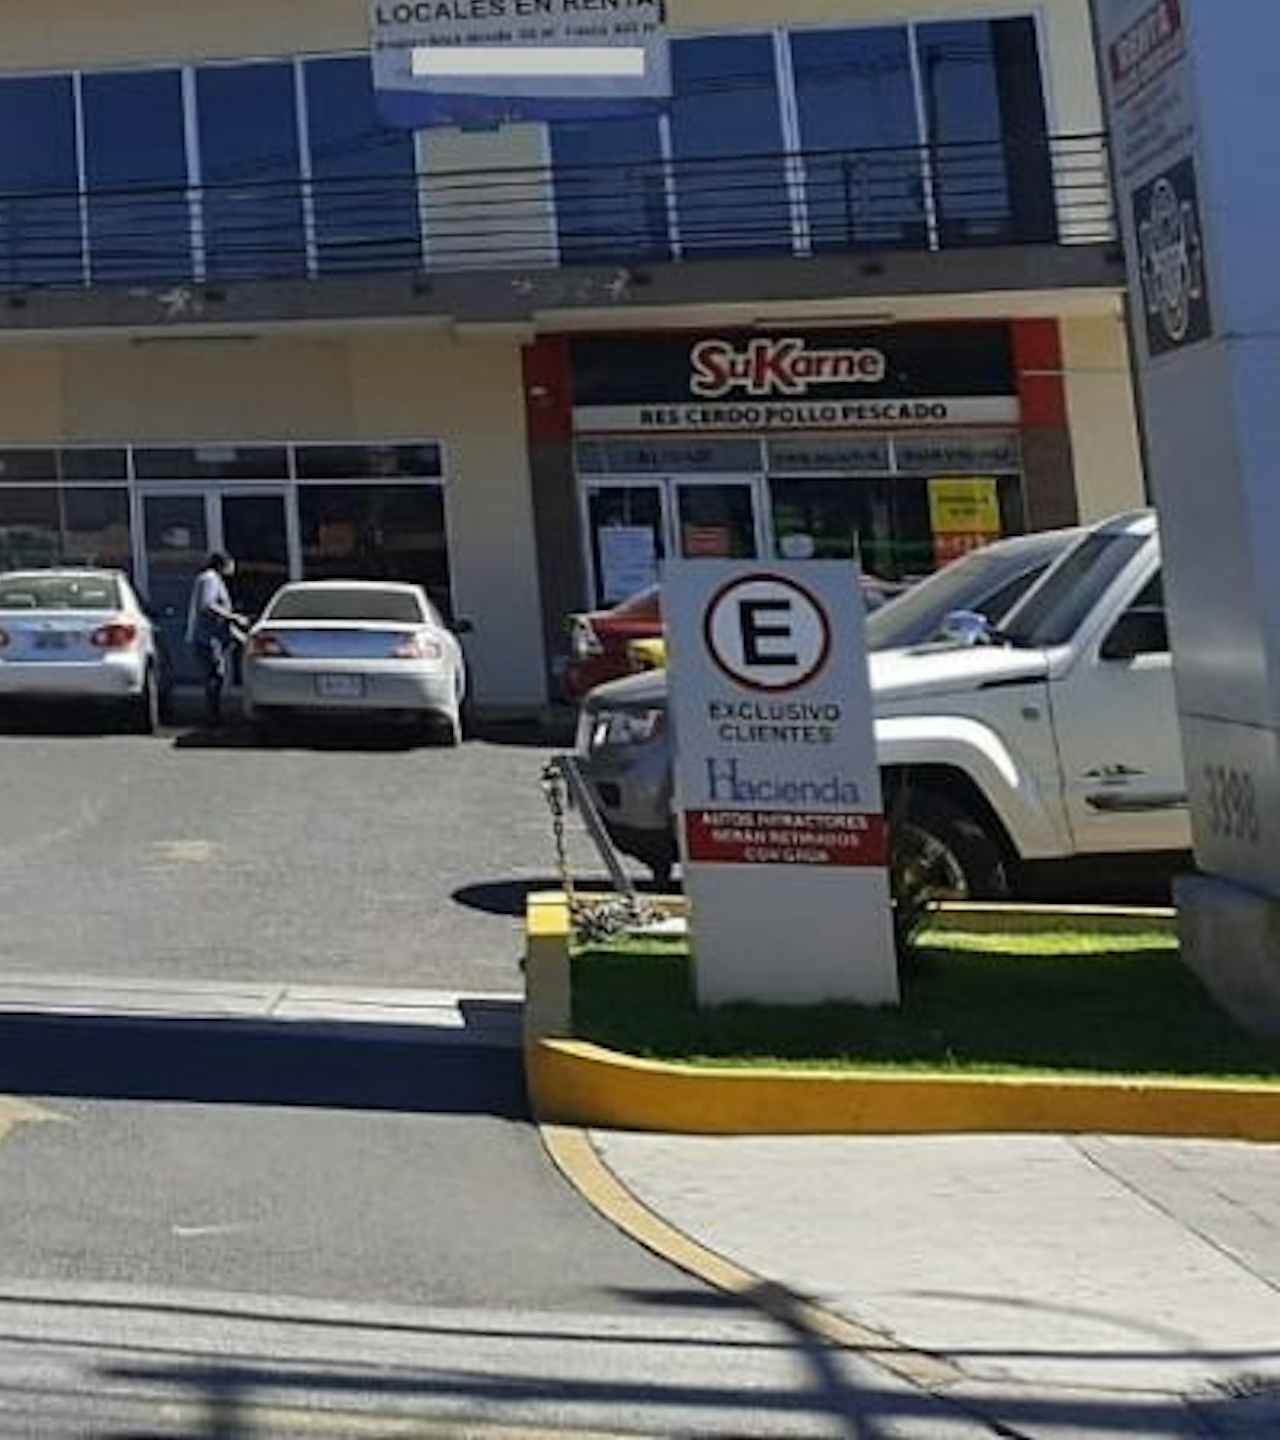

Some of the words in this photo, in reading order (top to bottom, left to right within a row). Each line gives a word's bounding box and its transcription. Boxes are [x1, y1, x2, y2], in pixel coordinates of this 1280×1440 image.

[690, 339, 885, 396] SuKarne
[641, 411, 680, 425] RES
[686, 408, 760, 424] CERDO
[765, 406, 837, 423] POLLO
[842, 403, 947, 420] PESCADO
[738, 599, 798, 666] E
[709, 703, 841, 721] EXCLUSIVO
[719, 724, 833, 743] CLIENTES
[705, 758, 860, 803] Hacienda
